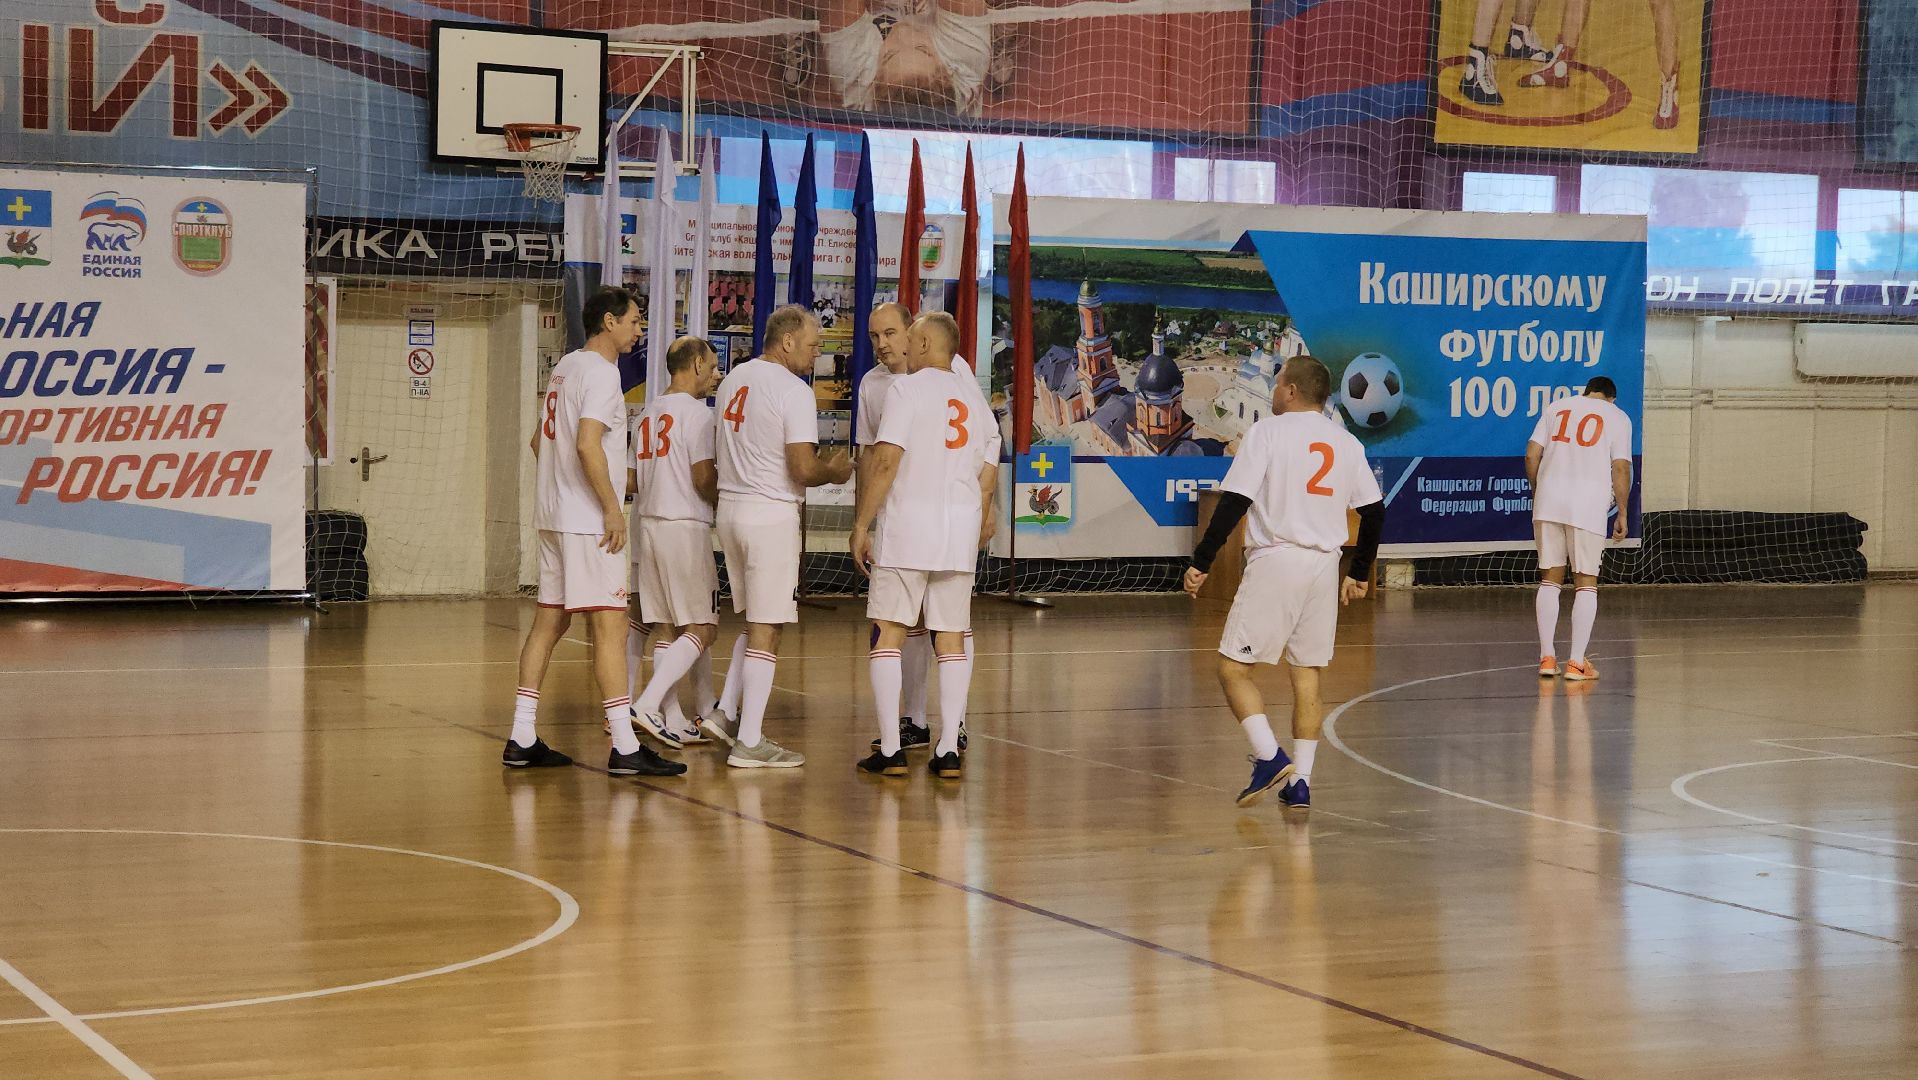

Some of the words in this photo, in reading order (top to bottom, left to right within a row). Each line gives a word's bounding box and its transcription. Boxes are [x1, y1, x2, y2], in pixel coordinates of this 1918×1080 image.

[82, 254, 142, 266] ЕДИНАЯ
[305, 228, 439, 259] ИКА
[82, 266, 142, 279] РОССИЯ
[1359, 261, 1607, 313] Каширскому
[1725, 277, 1854, 306] ПОЛЕТ
[543, 391, 558, 440] 8
[724, 385, 749, 432] 4
[1448, 376, 1517, 418] 100
[637, 413, 674, 460] 13
[945, 398, 969, 450] 3
[1551, 409, 1604, 448] 10
[16, 449, 272, 505] РОССИЯ!
[1306, 442, 1335, 496] 2
[1417, 476, 1483, 495] Каширская
[1421, 497, 1486, 516] Федерация
